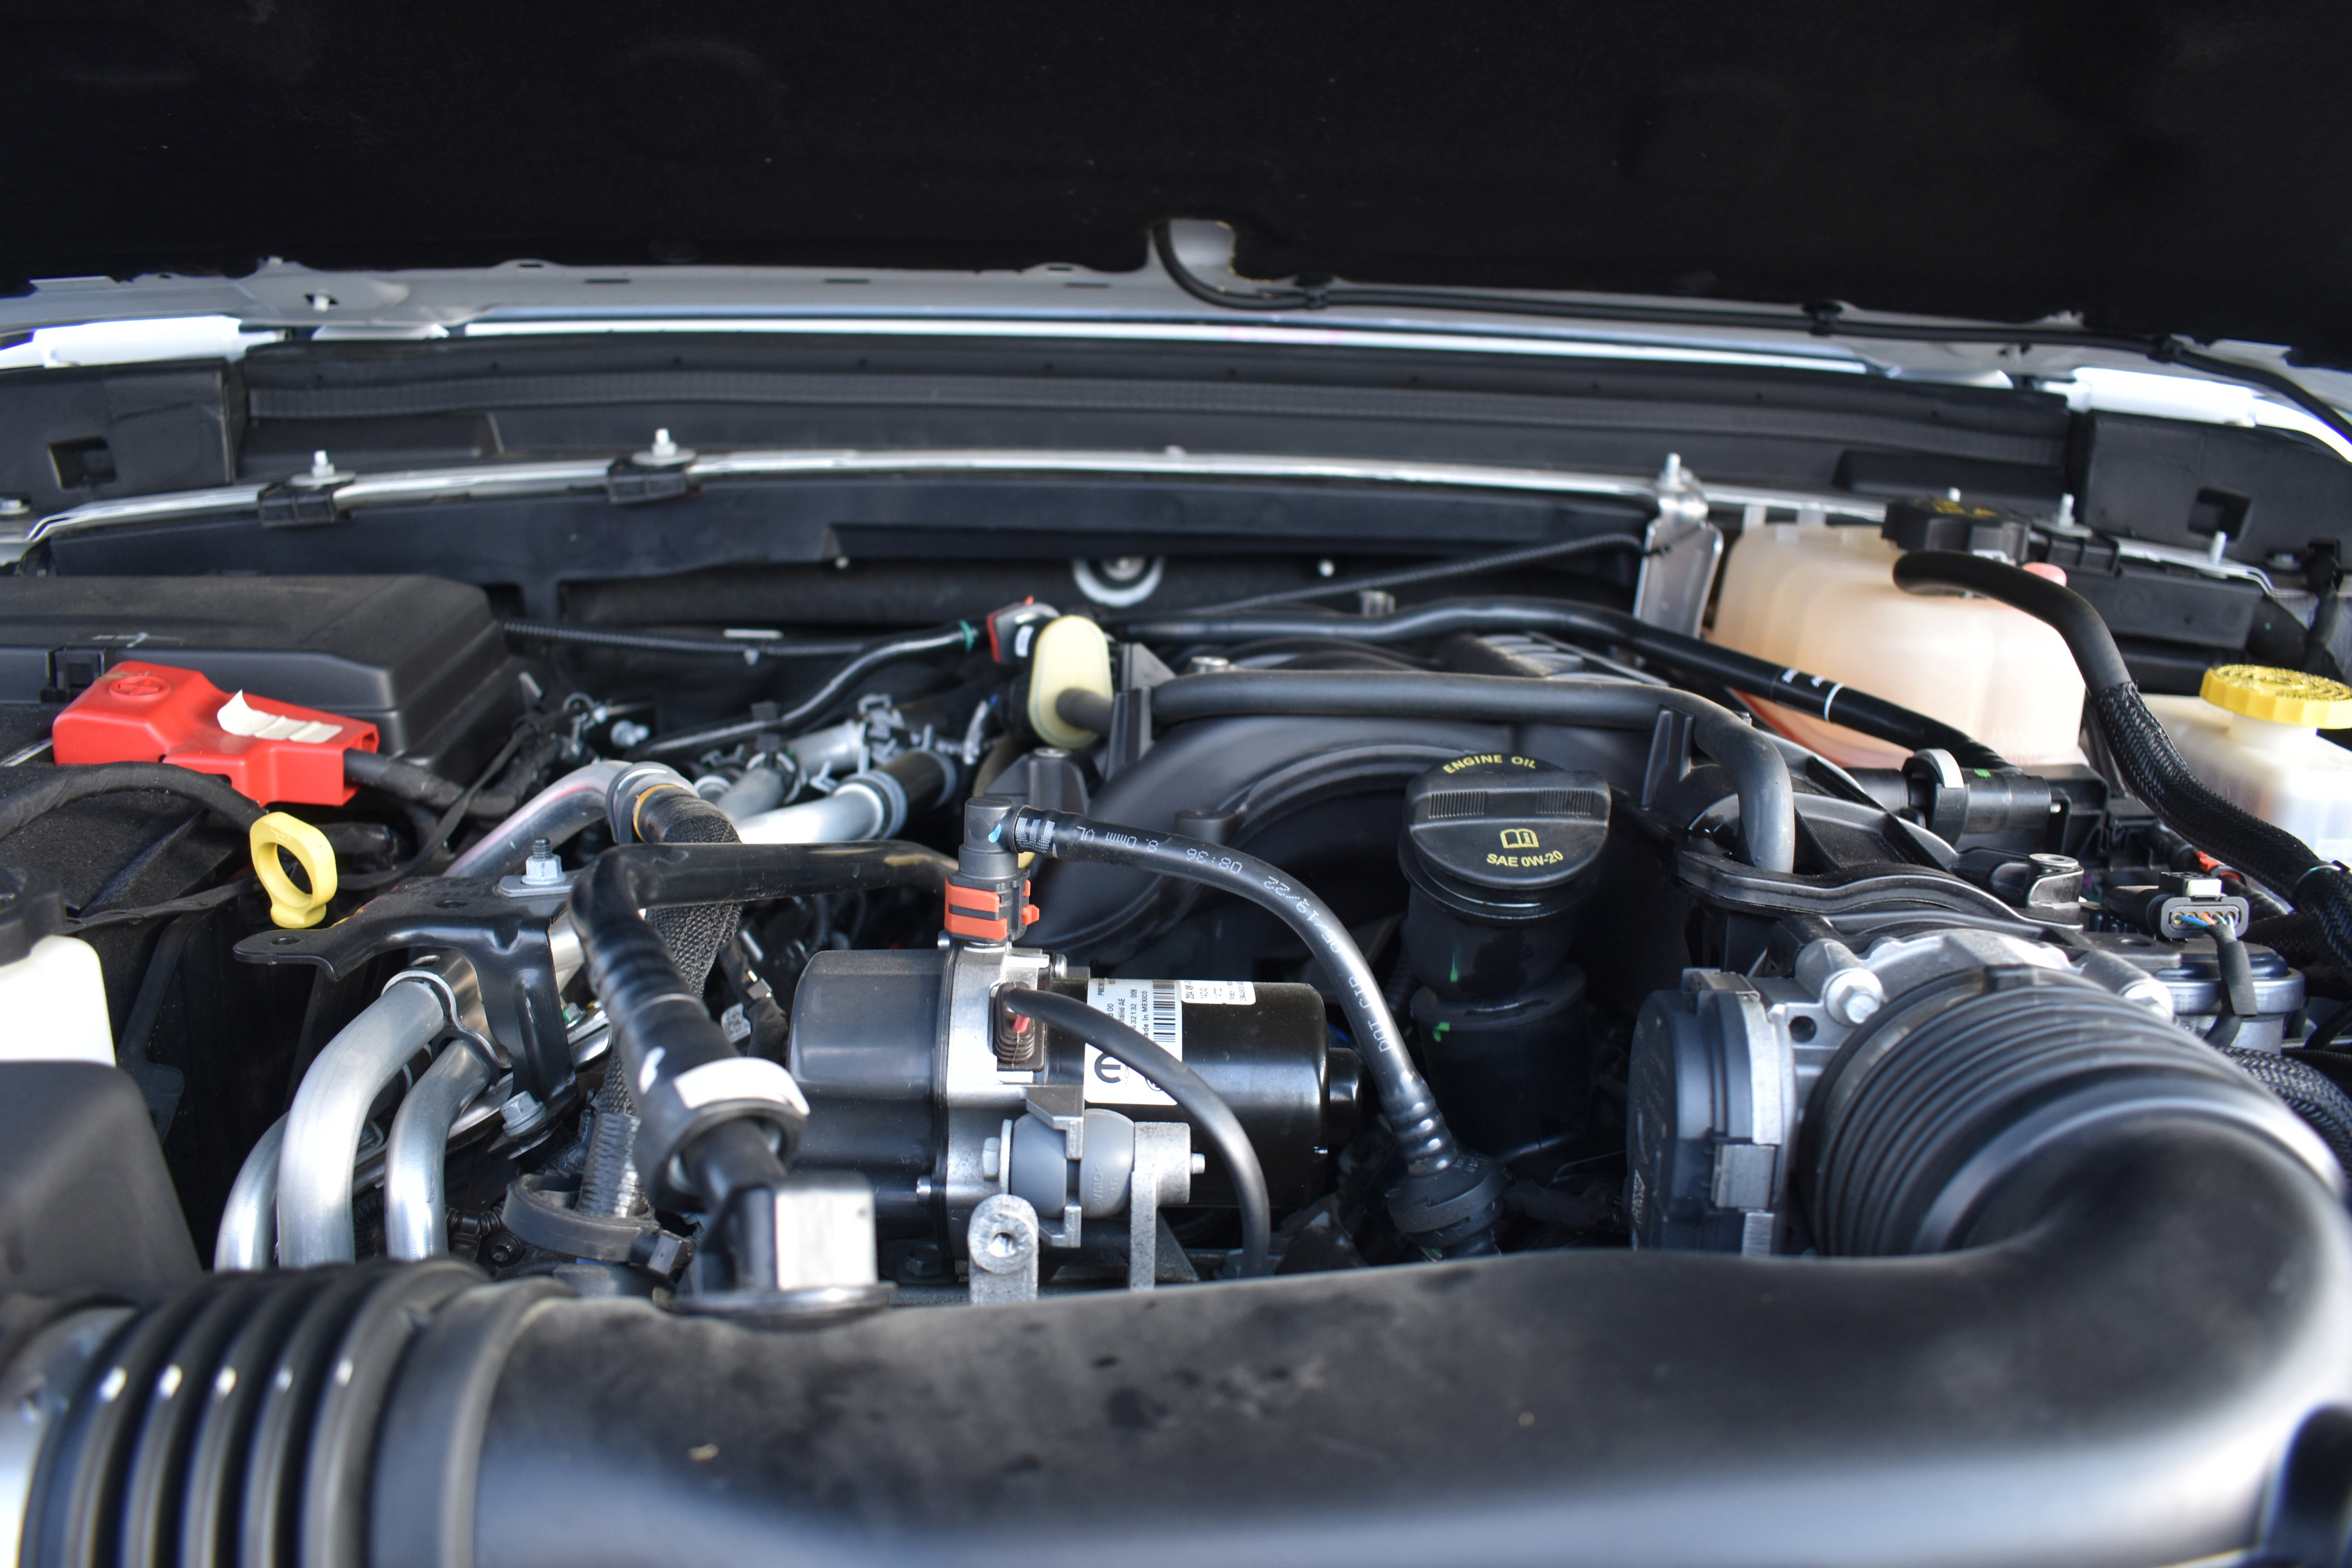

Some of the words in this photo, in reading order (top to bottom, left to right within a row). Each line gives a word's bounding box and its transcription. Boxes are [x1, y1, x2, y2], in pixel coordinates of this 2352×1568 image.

[1443, 754, 1503, 774] ENGINE
[1511, 755, 1537, 769] OIL
[1186, 848, 1243, 874] 08:36
[1486, 853, 1518, 867] SAE
[1521, 850, 1564, 867] 0W-20
